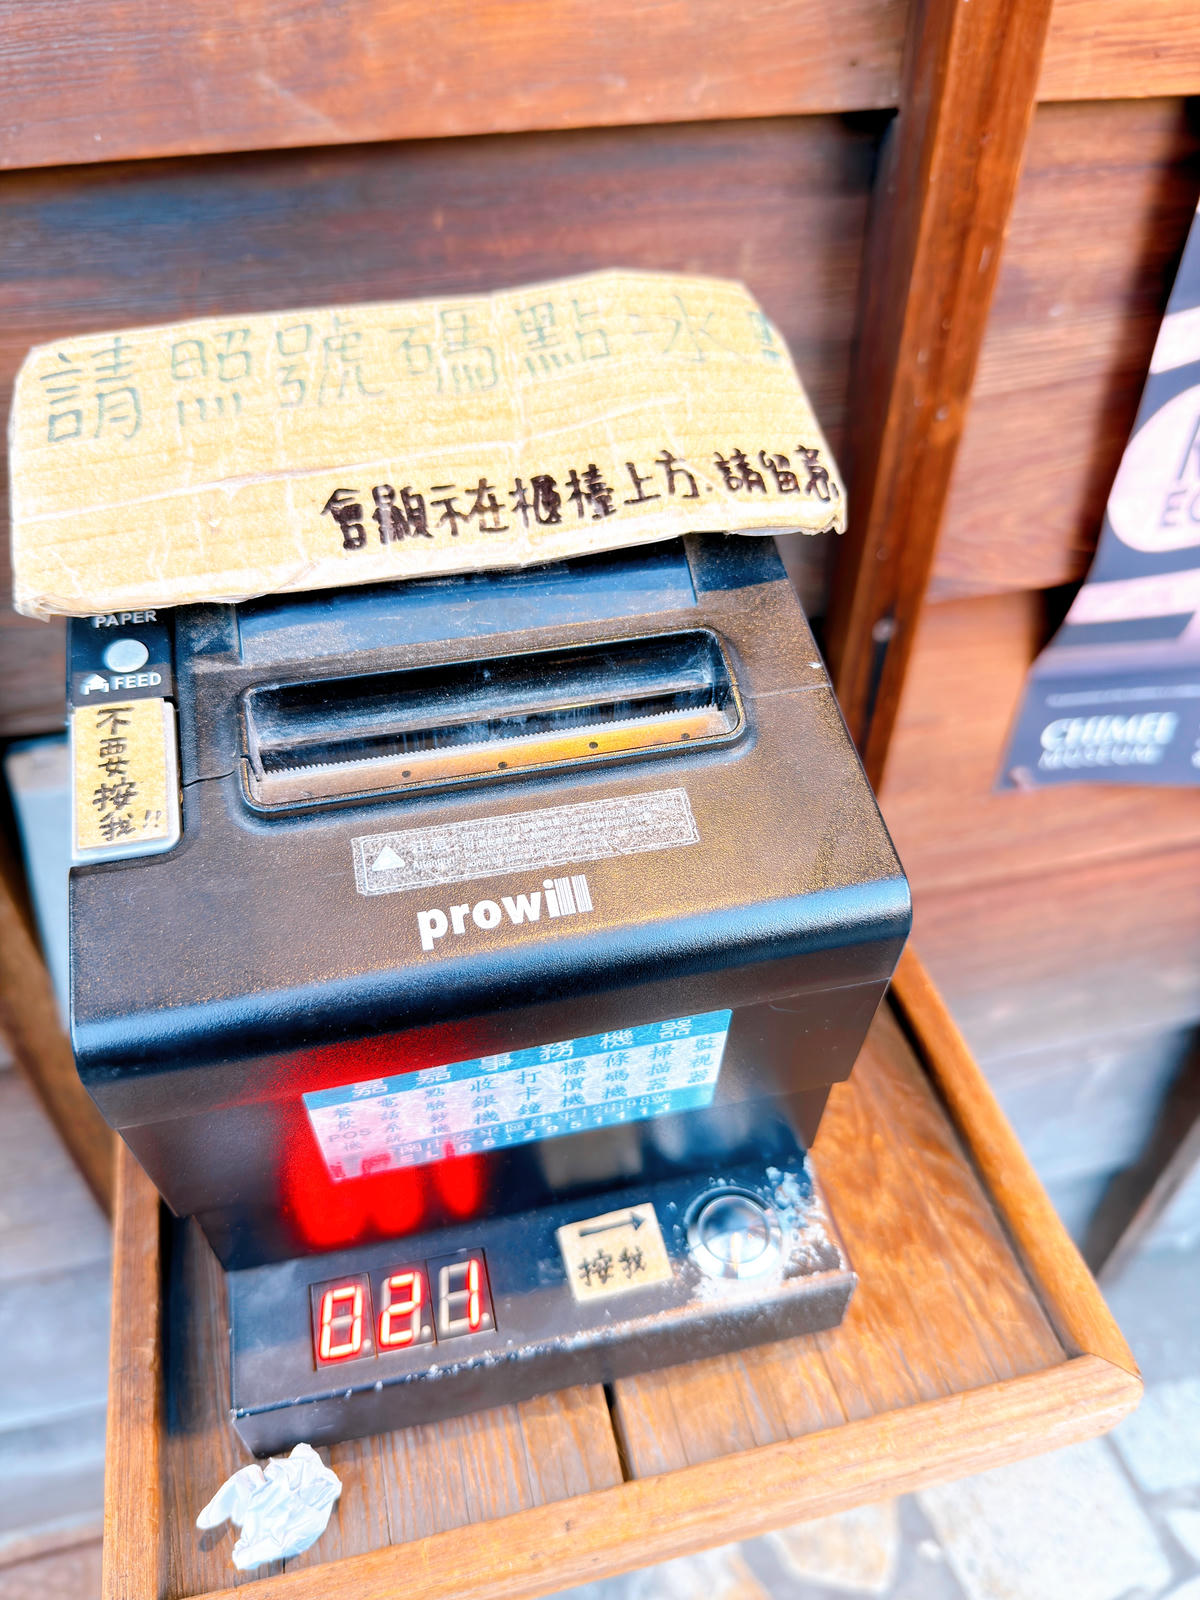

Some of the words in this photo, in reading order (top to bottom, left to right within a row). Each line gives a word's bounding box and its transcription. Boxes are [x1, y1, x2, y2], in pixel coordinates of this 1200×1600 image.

[94, 609, 158, 628] PAPER
[111, 671, 162, 690] FEED
[417, 873, 593, 951] prowill
[319, 1258, 482, 1361] 021
